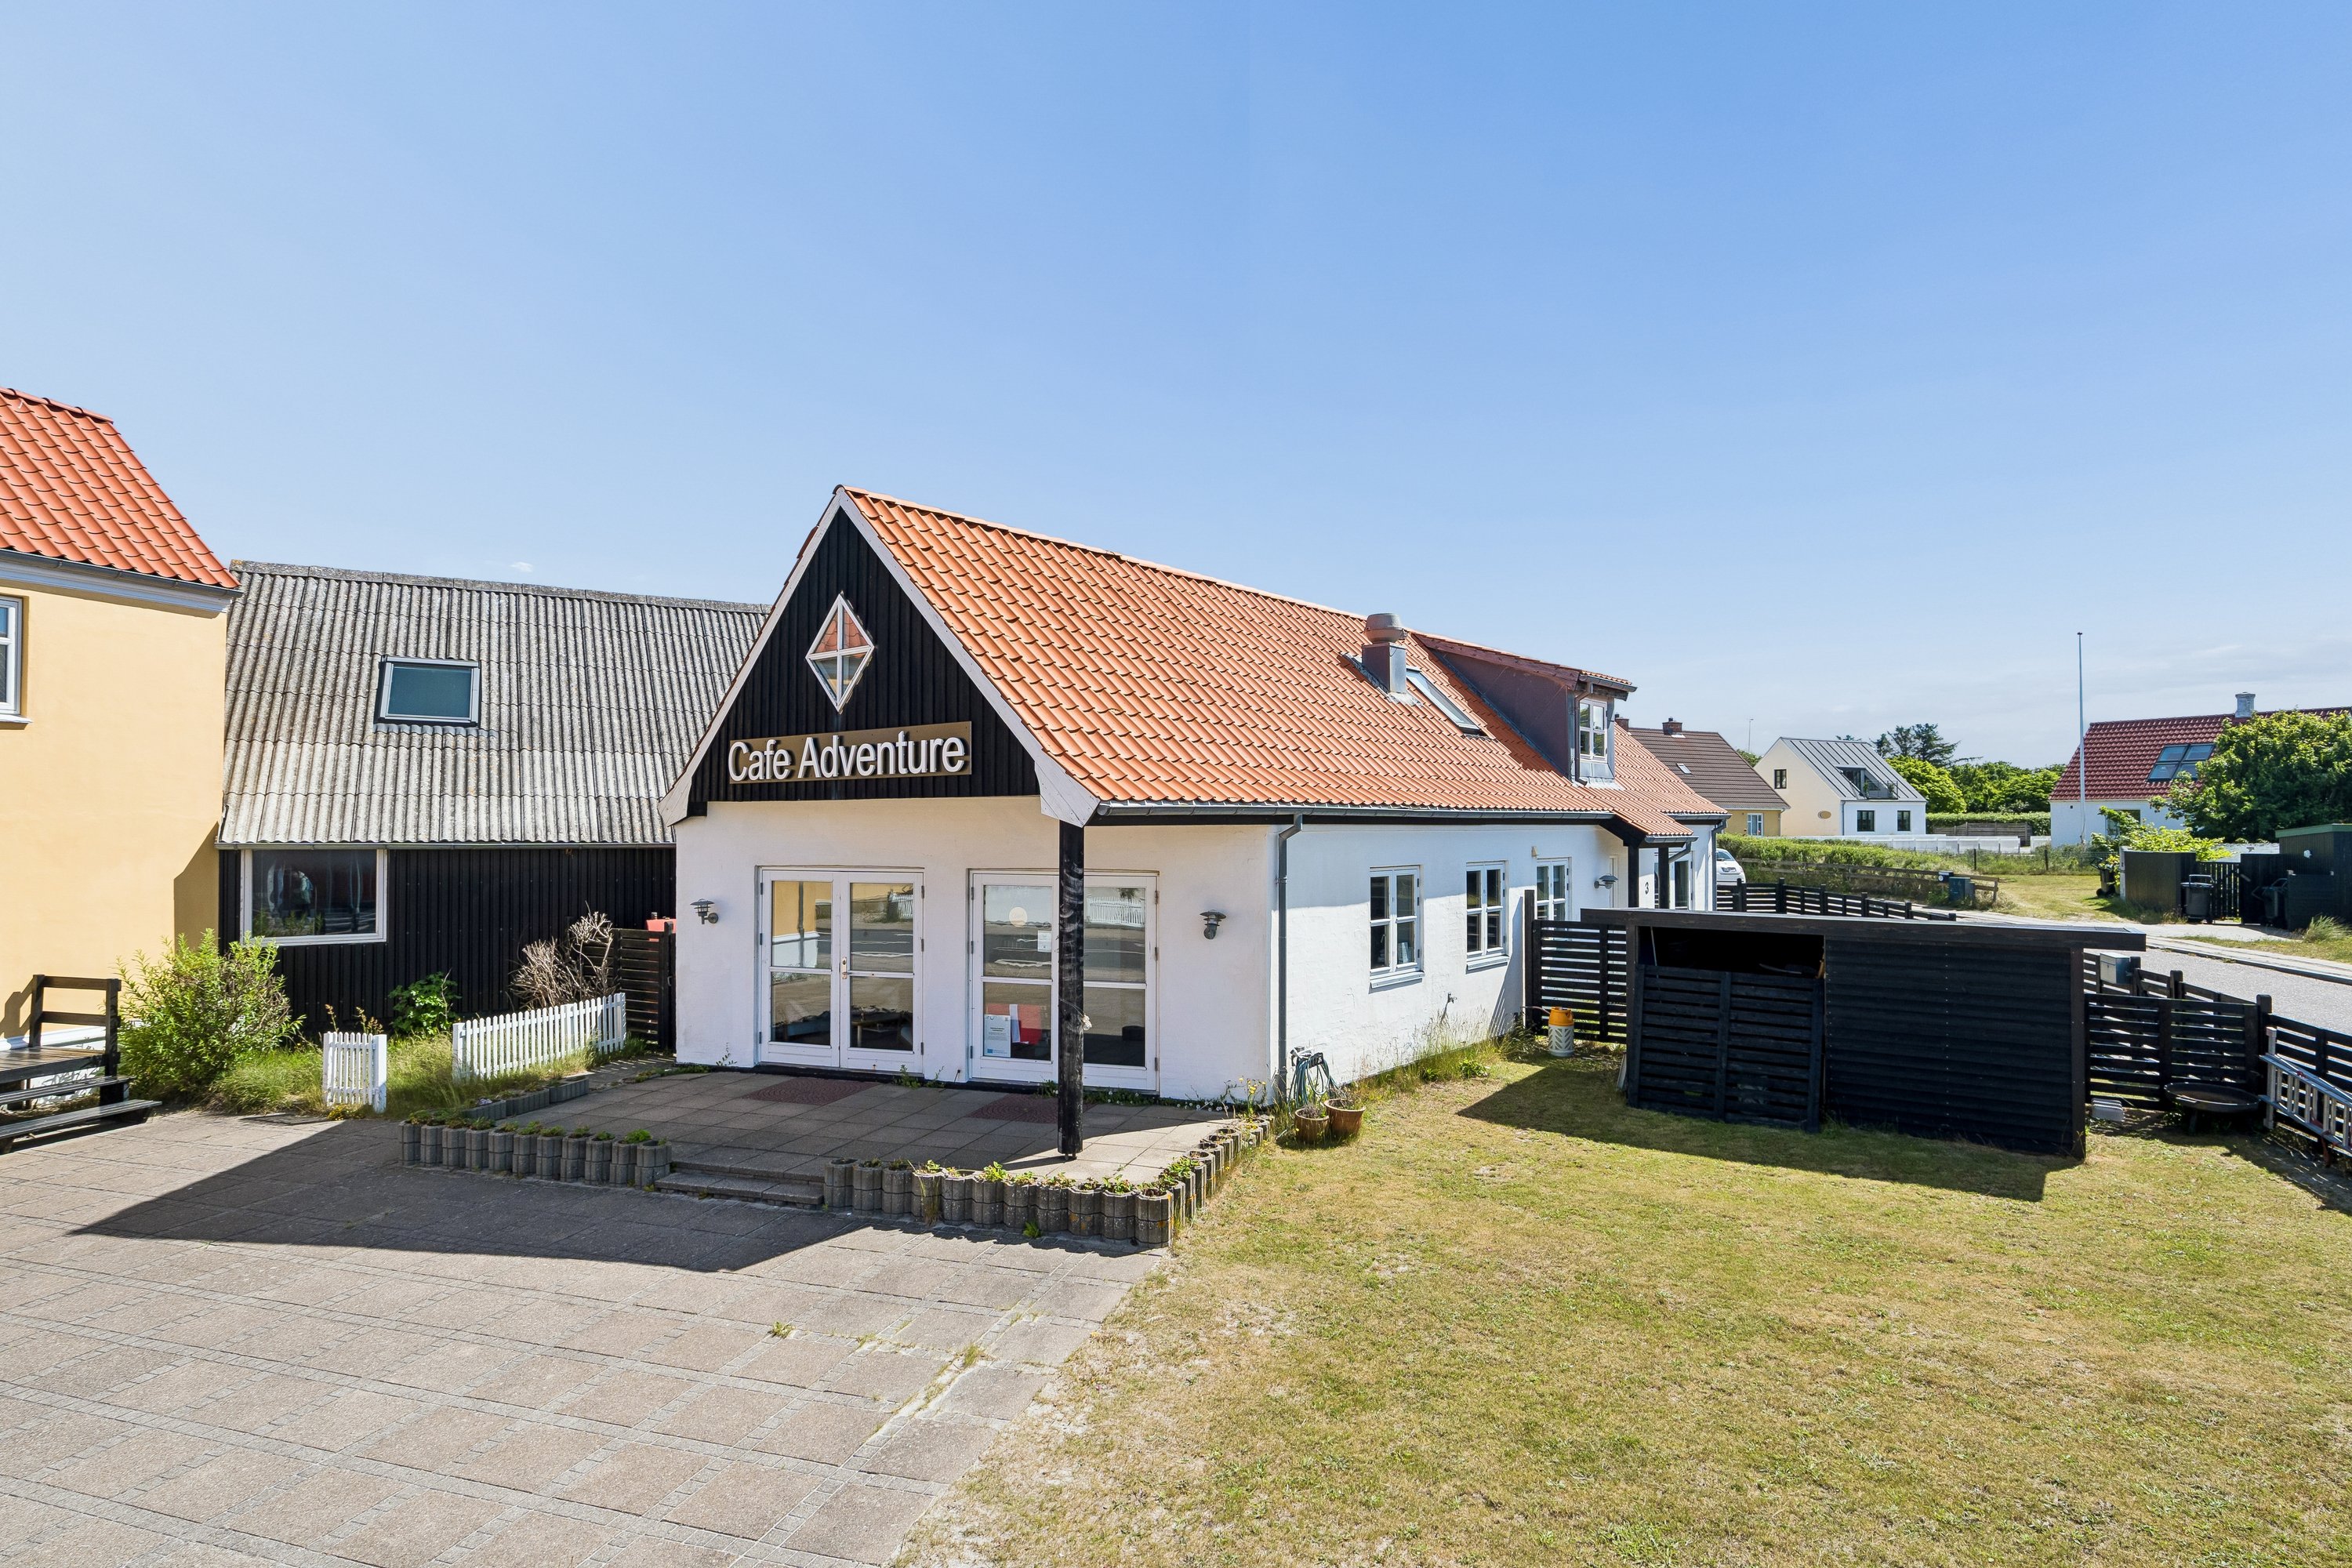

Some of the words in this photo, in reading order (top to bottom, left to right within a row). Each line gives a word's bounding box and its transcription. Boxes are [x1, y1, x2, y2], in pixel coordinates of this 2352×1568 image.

[728, 739, 791, 782] Cafe
[798, 731, 965, 779] Adventure
[1645, 881, 1650, 895] 3
